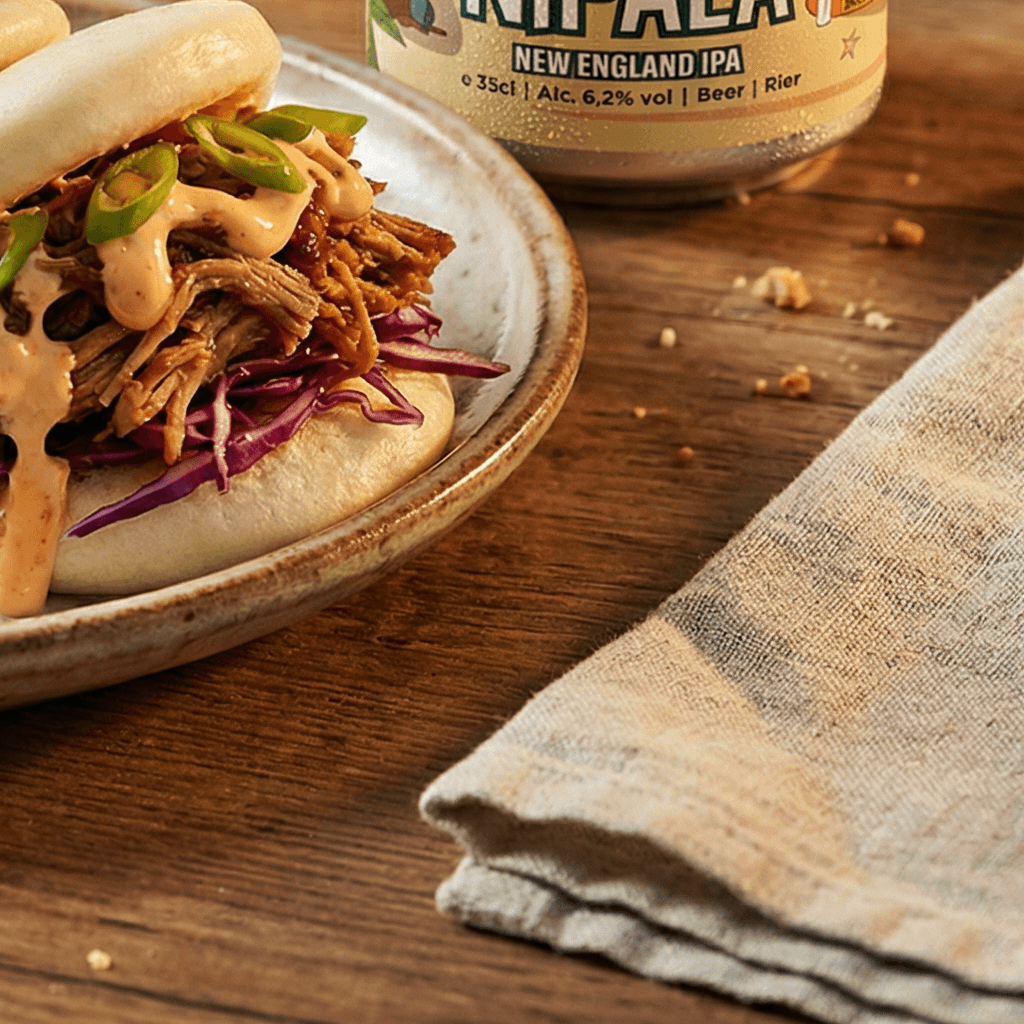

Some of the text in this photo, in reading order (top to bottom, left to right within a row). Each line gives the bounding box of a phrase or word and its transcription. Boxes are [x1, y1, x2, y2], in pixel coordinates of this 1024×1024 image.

[514, 44, 742, 79] NEW ENGLAND IPA
[477, 74, 516, 97] 35cl
[537, 85, 576, 104] Alc.
[582, 89, 635, 107] 6,2%
[640, 89, 673, 106] vol
[697, 85, 746, 103] Beer
